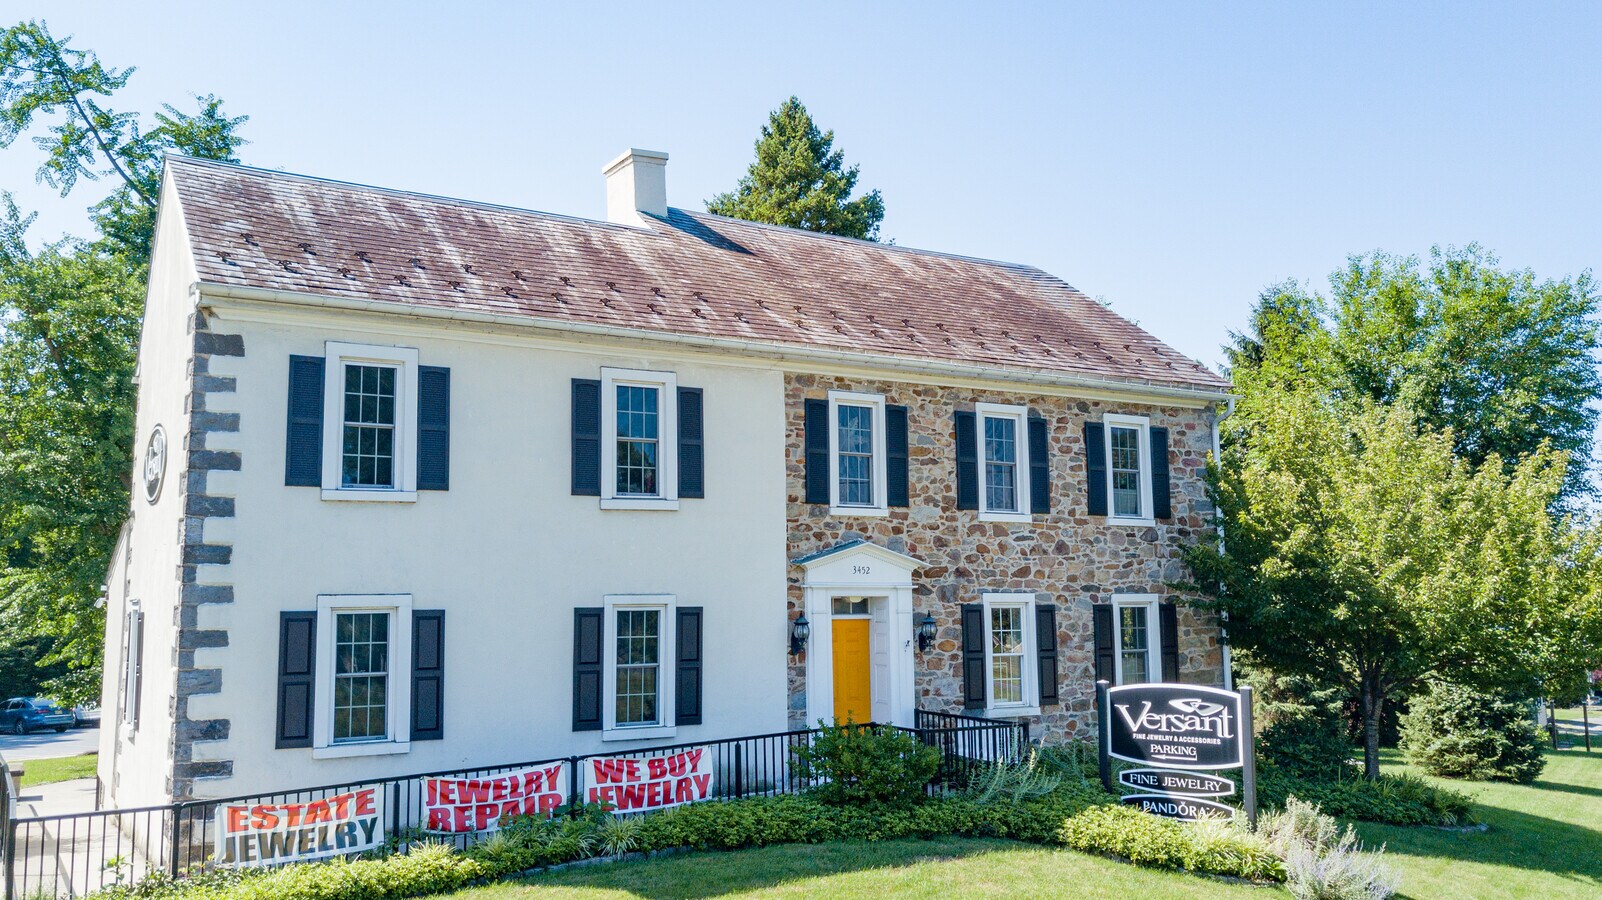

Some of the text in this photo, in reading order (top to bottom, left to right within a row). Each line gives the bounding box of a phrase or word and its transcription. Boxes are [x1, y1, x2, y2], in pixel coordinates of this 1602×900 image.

[852, 565, 871, 575] 3452
[1114, 700, 1234, 739] Versant
[1147, 734, 1173, 742] JEWELRY
[1179, 736, 1221, 745] ACCESSORIES
[1150, 744, 1197, 756] PARKING
[426, 765, 561, 806] JEWELRY
[593, 748, 703, 784] WE BUY
[1130, 773, 1222, 792] FINE JEWELRY
[227, 788, 376, 833] ESTATE
[589, 773, 711, 812] JEWELRY
[426, 793, 563, 832] REPAIR
[222, 817, 378, 863] JEWELRY
